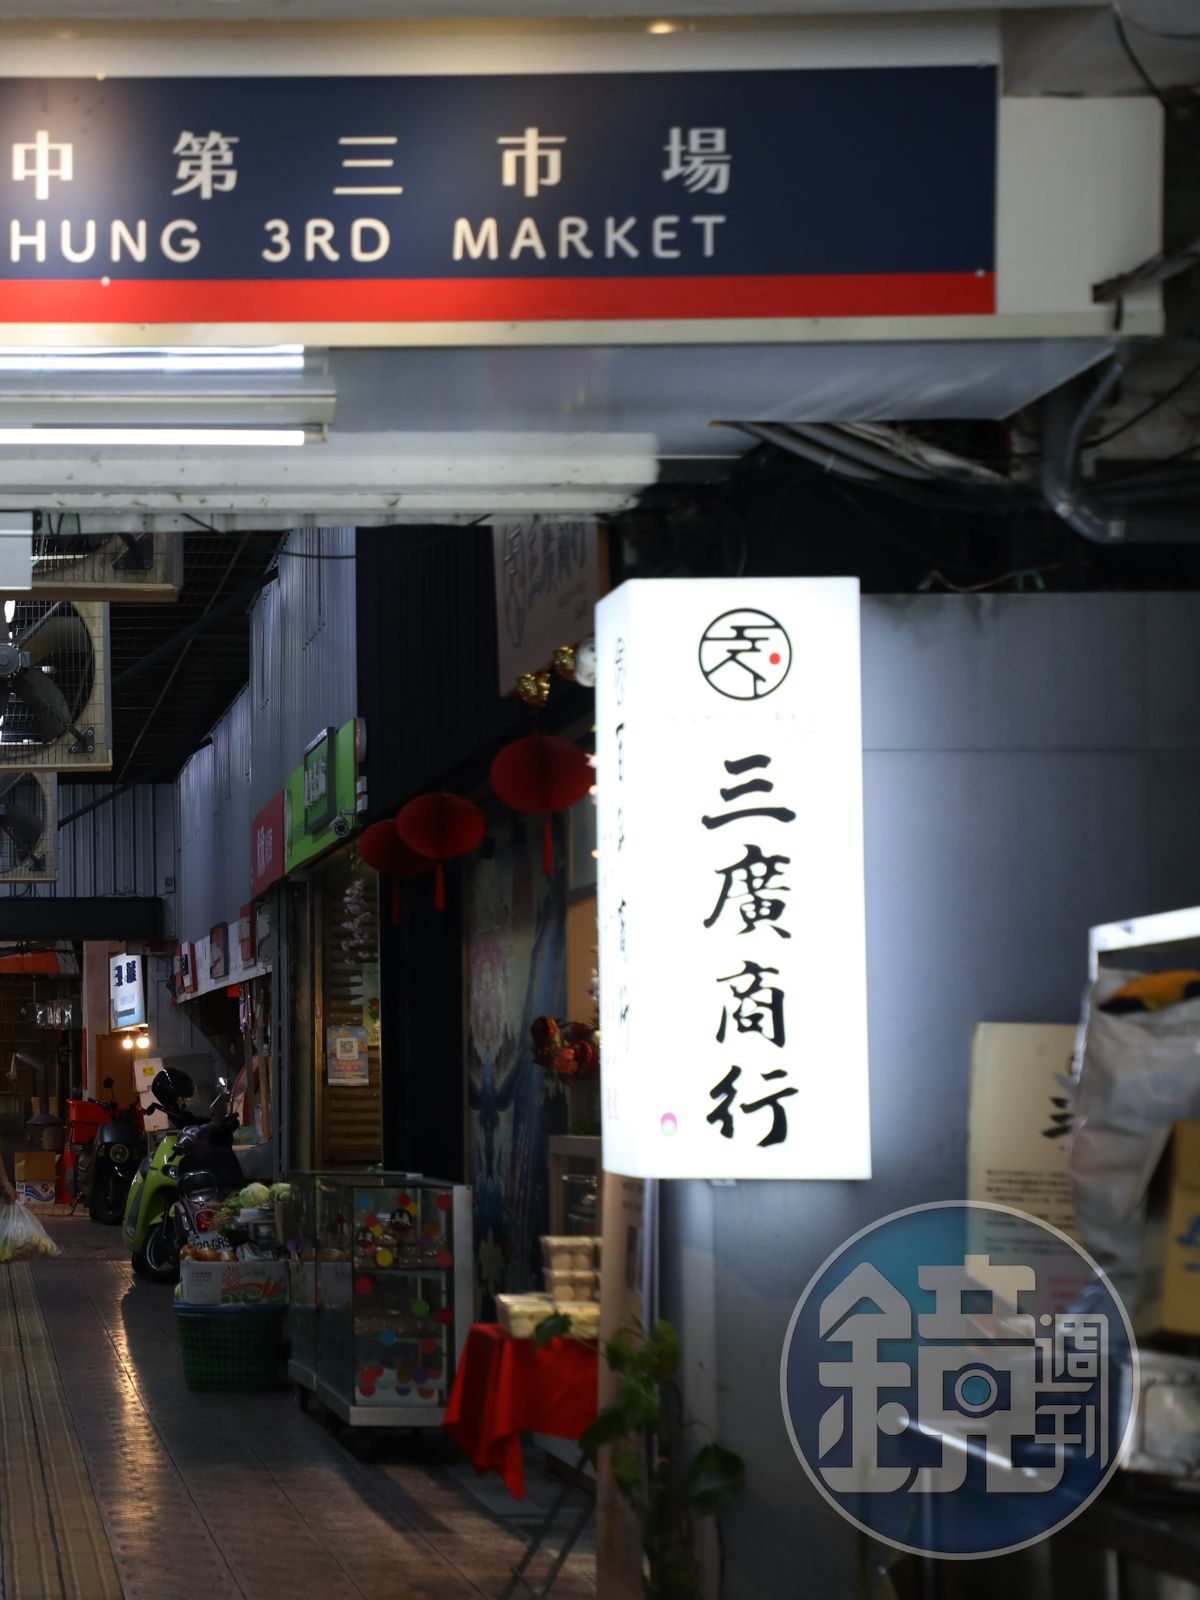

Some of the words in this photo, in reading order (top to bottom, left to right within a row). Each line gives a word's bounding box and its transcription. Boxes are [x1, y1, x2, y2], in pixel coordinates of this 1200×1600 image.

[261, 217, 391, 263] 3RD
[451, 214, 727, 262] MARKET
[701, 753, 800, 1148] 三廣商行
